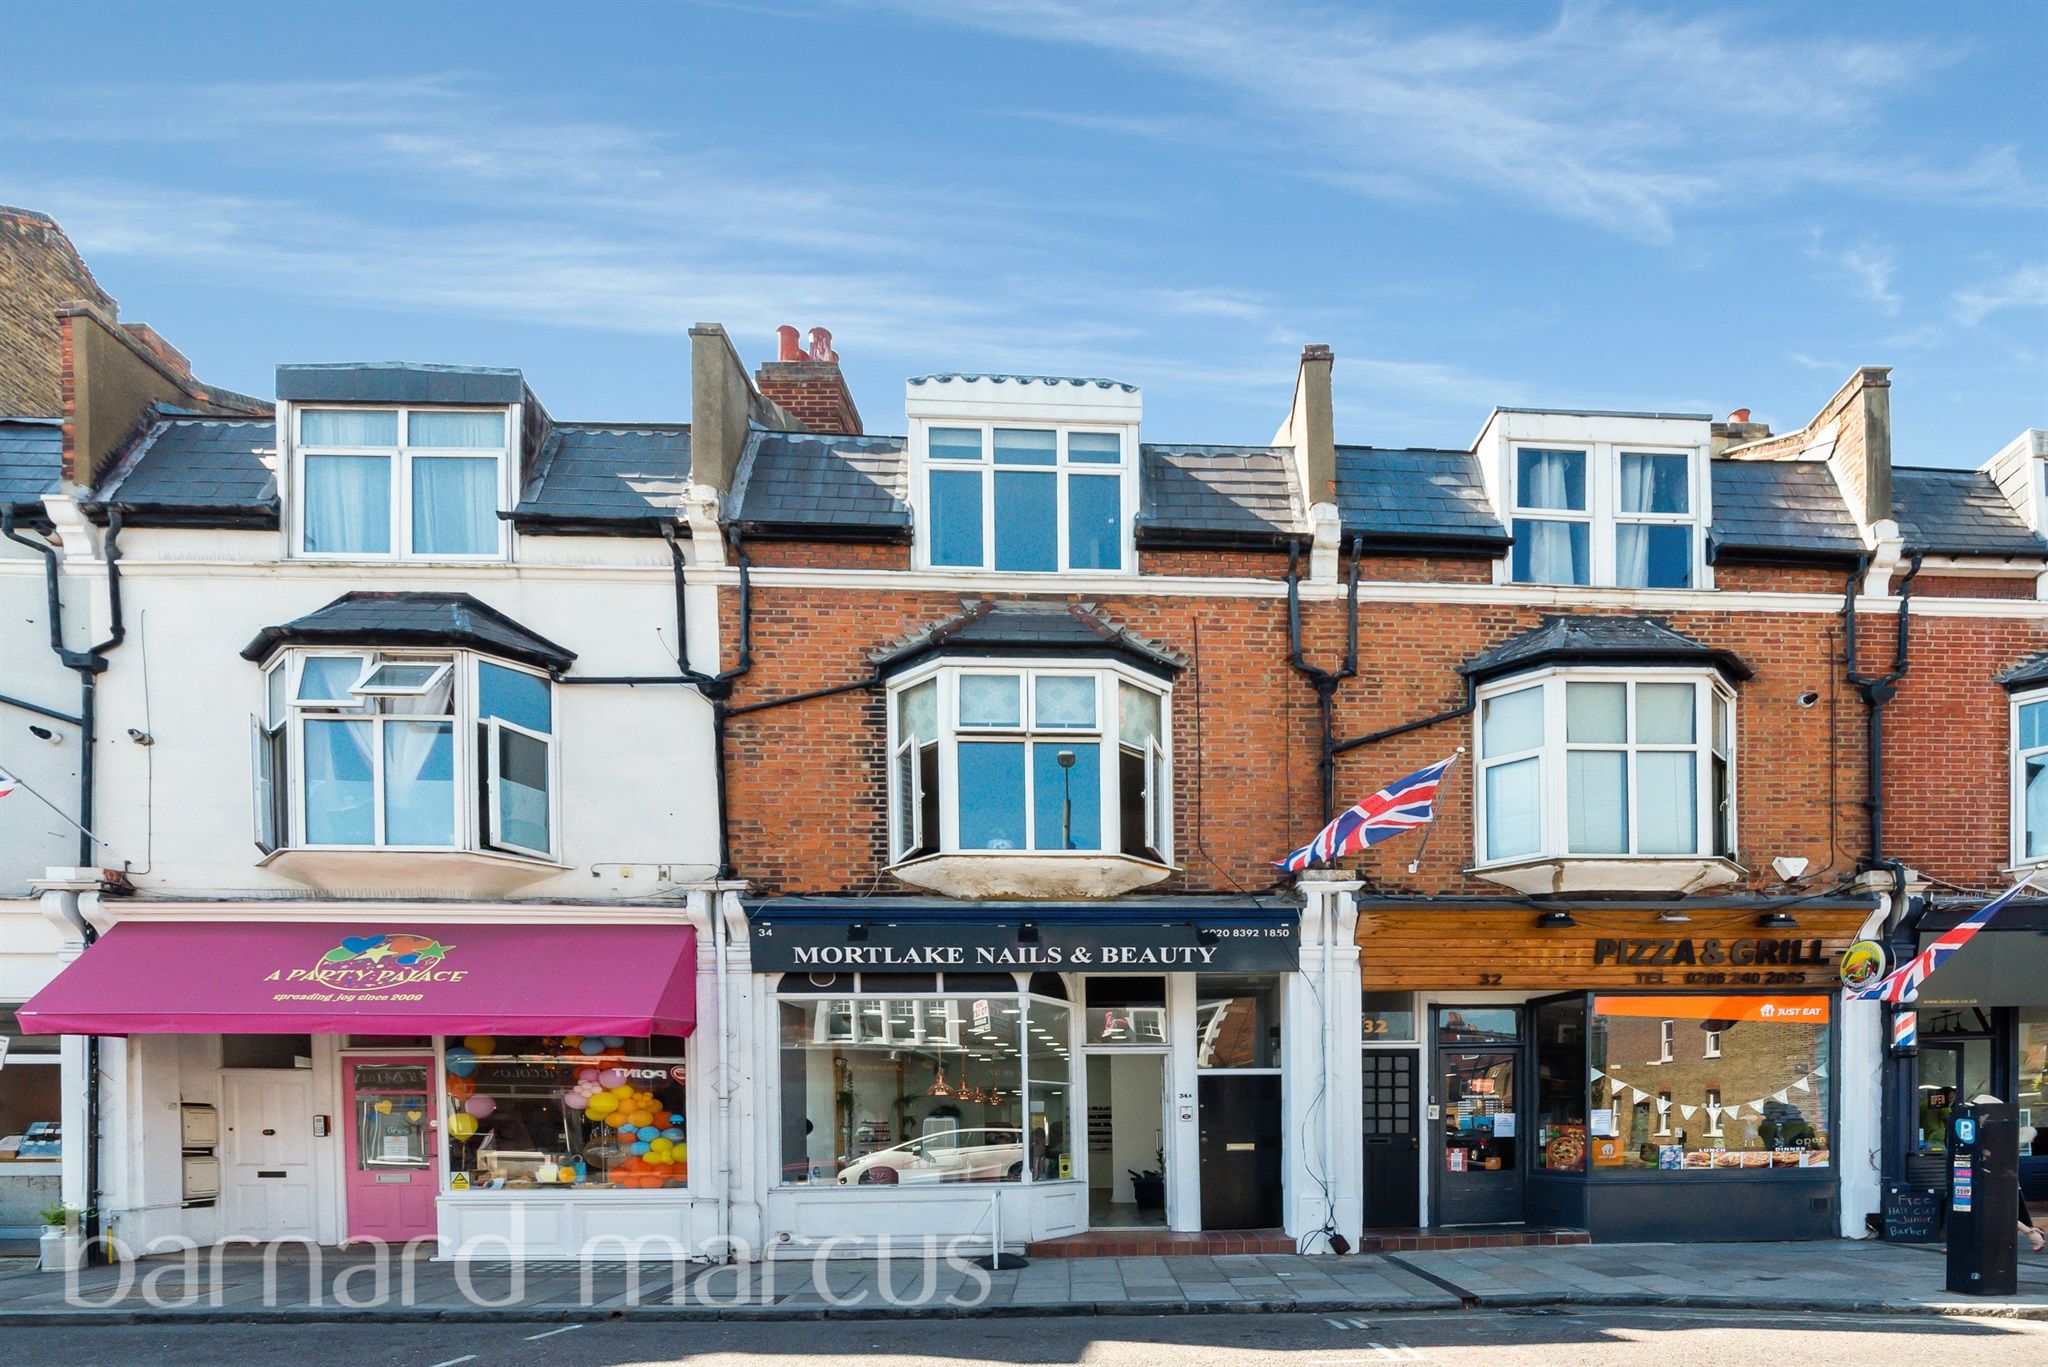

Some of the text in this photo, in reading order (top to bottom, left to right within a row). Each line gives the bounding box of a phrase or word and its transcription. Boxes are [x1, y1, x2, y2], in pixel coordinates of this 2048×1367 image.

[758, 928, 773, 938] 34
[1232, 929, 1259, 938] 8392
[1263, 929, 1290, 938] 1850
[792, 946, 1219, 964] MORTLAKE NAILS & BEAUTY
[1594, 938, 1697, 966] PIZZA
[1730, 939, 1830, 965] GRILL
[263, 969, 469, 982] A PARTY PALACE
[1478, 973, 1503, 986] 32
[1634, 971, 1670, 985] TEL
[273, 992, 424, 1002] spreading joy since 2009
[1776, 1007, 1822, 1017] JUST EAT
[1363, 1019, 1389, 1034] 32
[1795, 1136, 1827, 1147] open
[1897, 1194, 1932, 1206] Free
[1890, 1225, 1928, 1237] Barber
